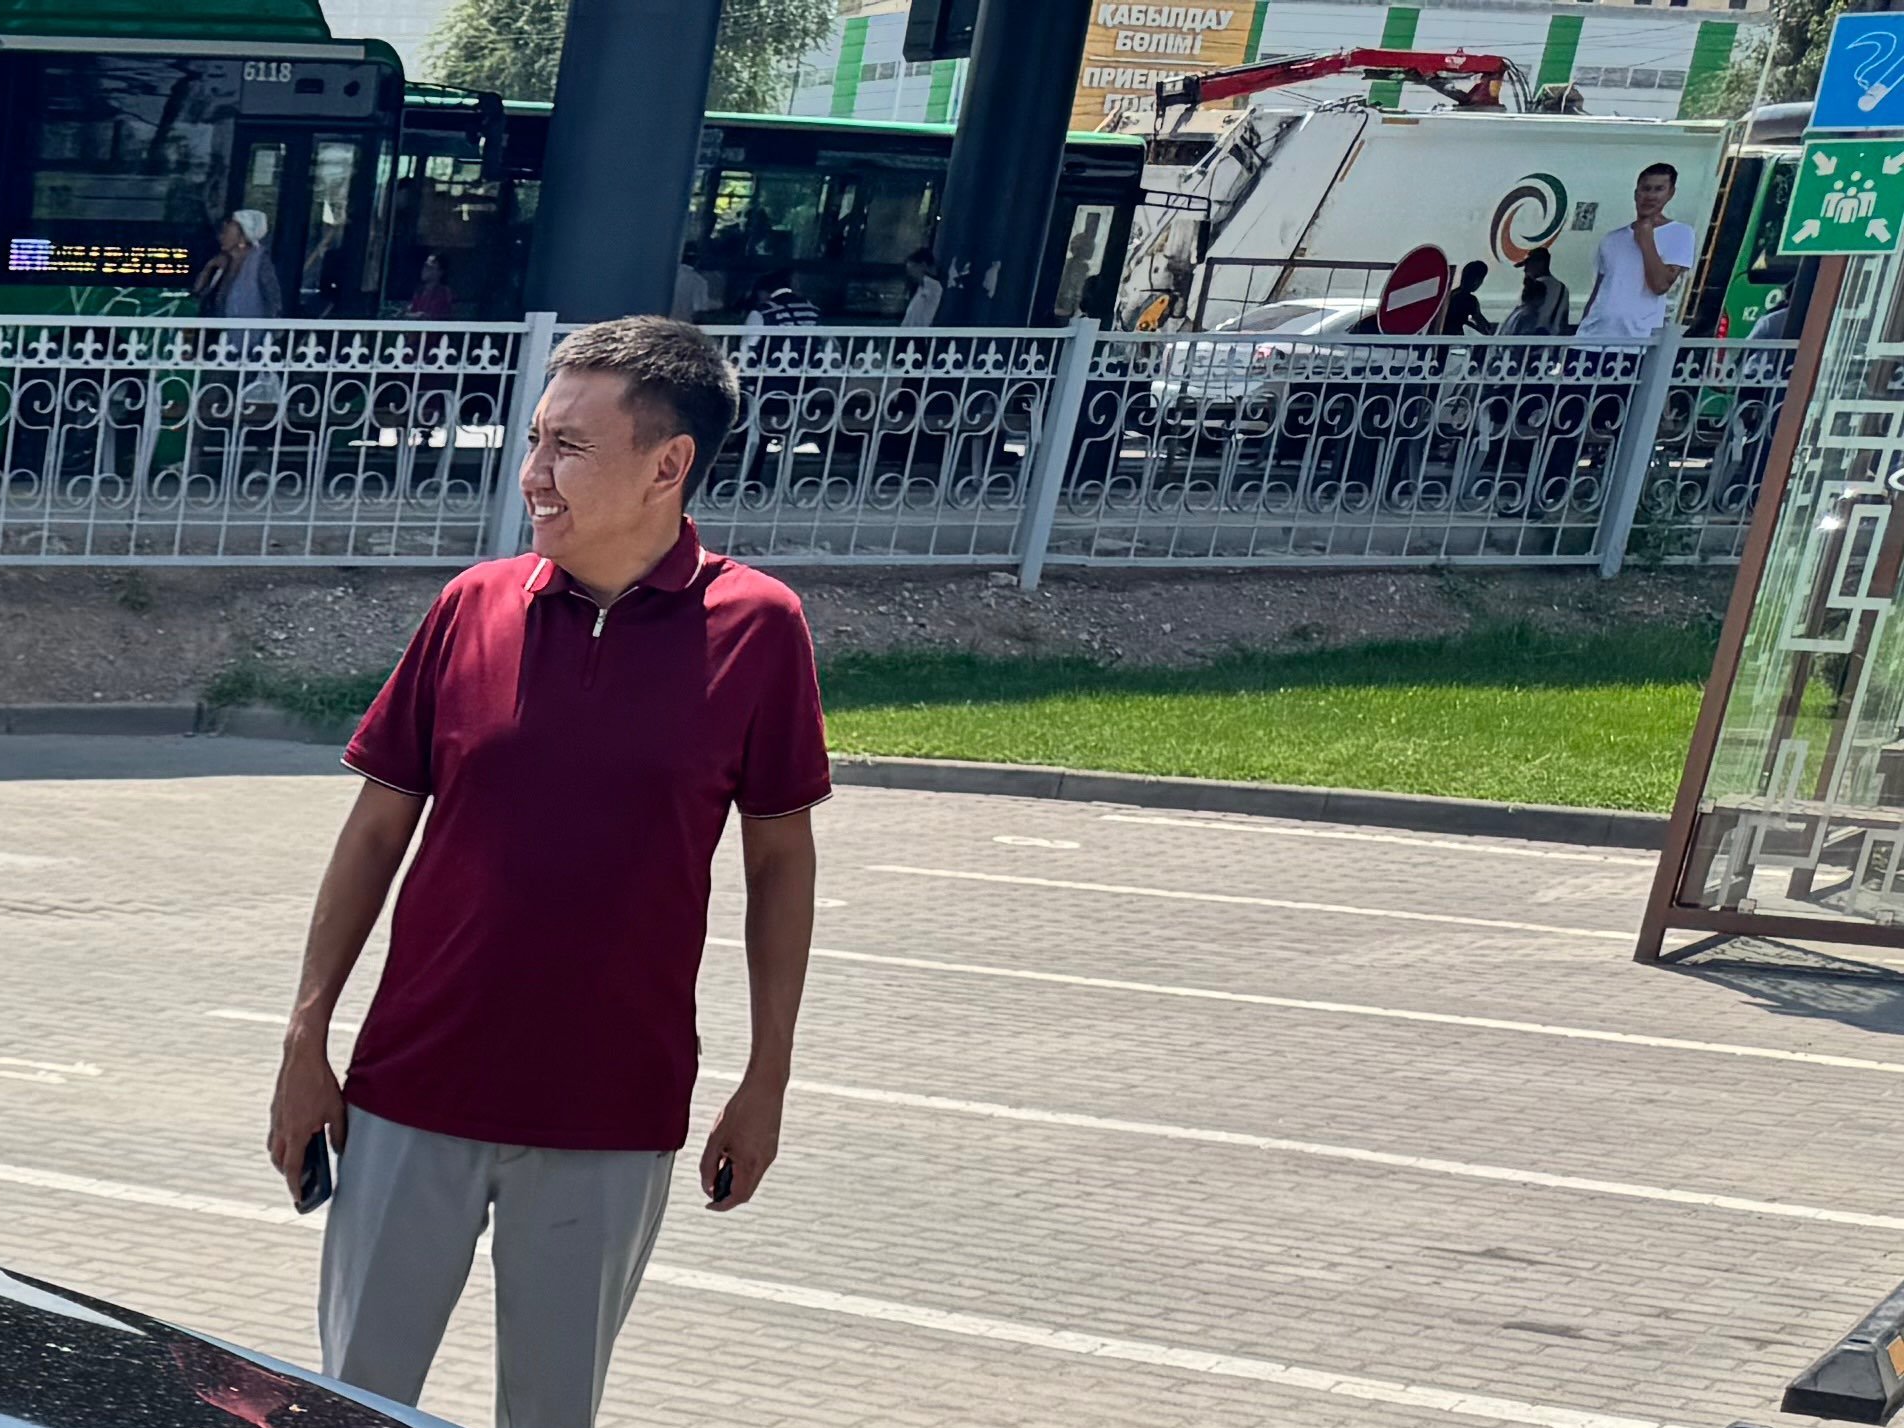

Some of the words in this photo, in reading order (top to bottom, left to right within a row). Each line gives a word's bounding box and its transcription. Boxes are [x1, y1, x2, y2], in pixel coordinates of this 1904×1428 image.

[1098, 4, 1234, 32] ҚАБЫЛДАУ
[1116, 30, 1204, 55] БӨЛІМІ
[244, 61, 291, 82] 6118
